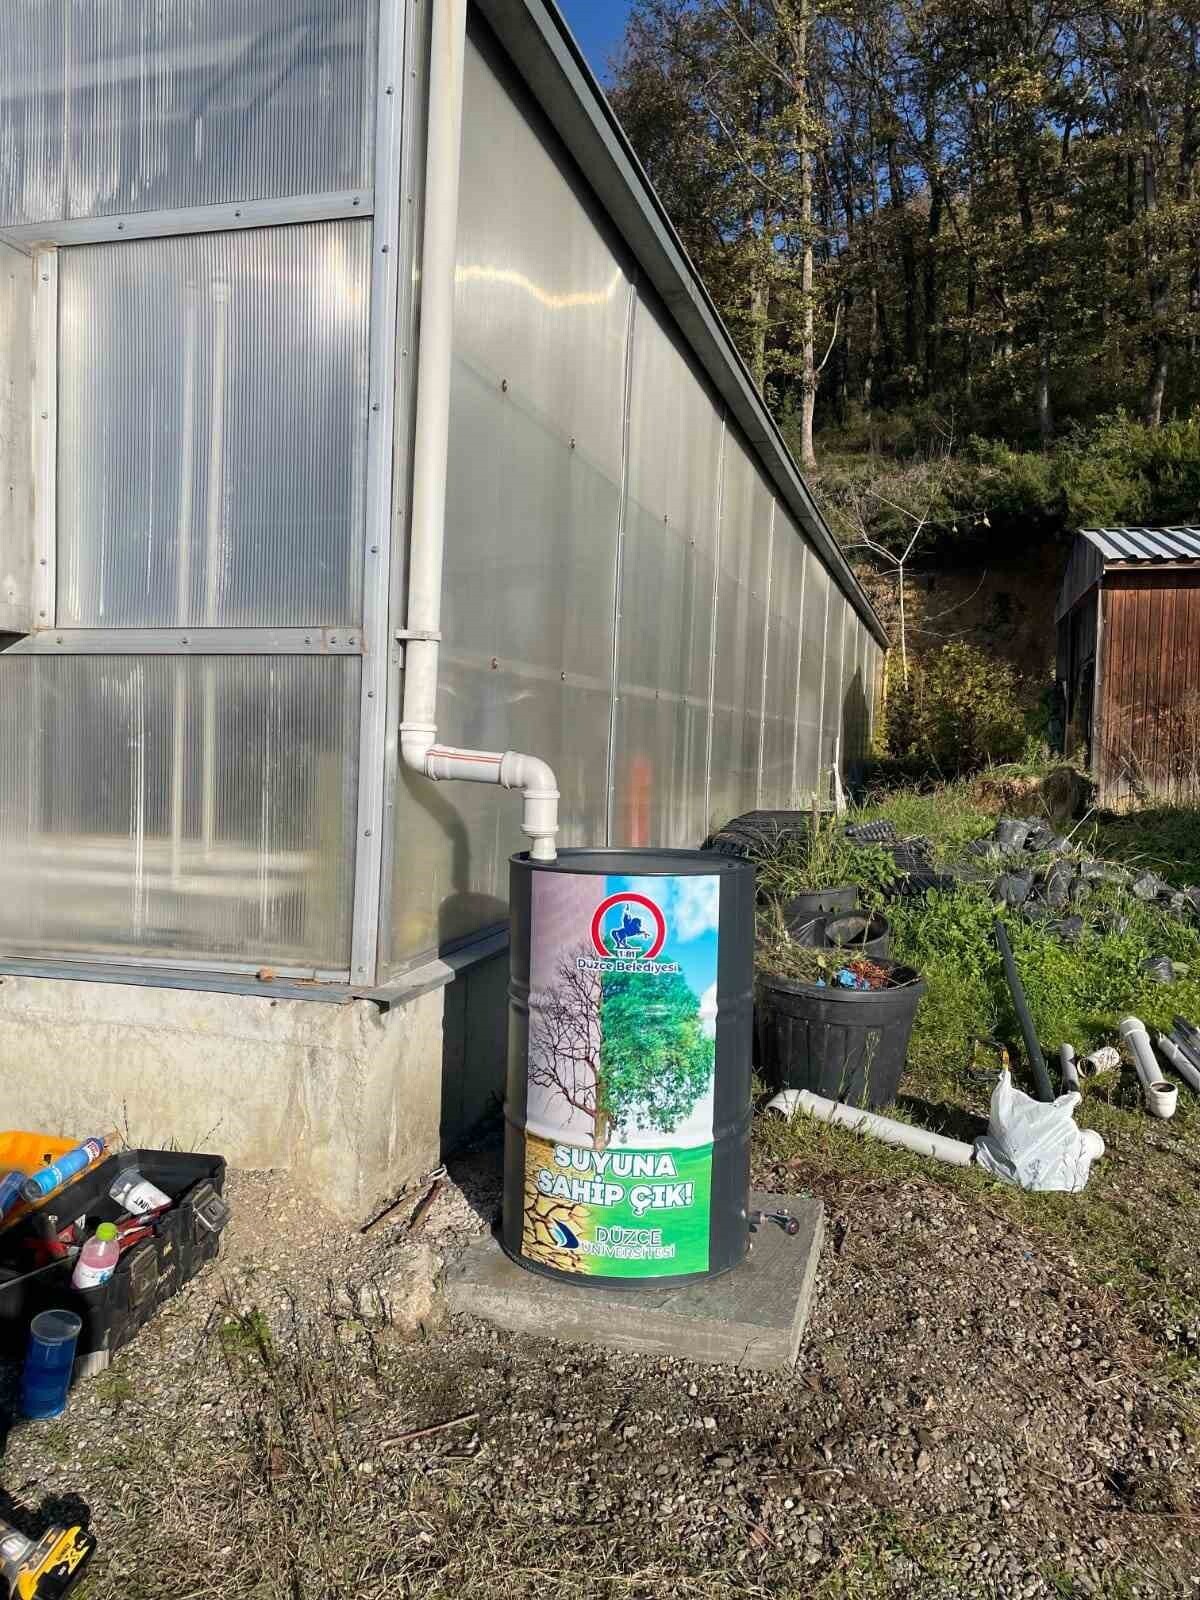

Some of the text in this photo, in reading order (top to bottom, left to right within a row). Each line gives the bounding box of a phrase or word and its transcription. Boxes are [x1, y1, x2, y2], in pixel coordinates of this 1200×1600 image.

[616, 960, 679, 974] Belediyesi
[554, 1144, 677, 1177] SUYUNA
[537, 1168, 696, 1217] SAHİP ÇIK!
[596, 1226, 662, 1246] DÜZCE
